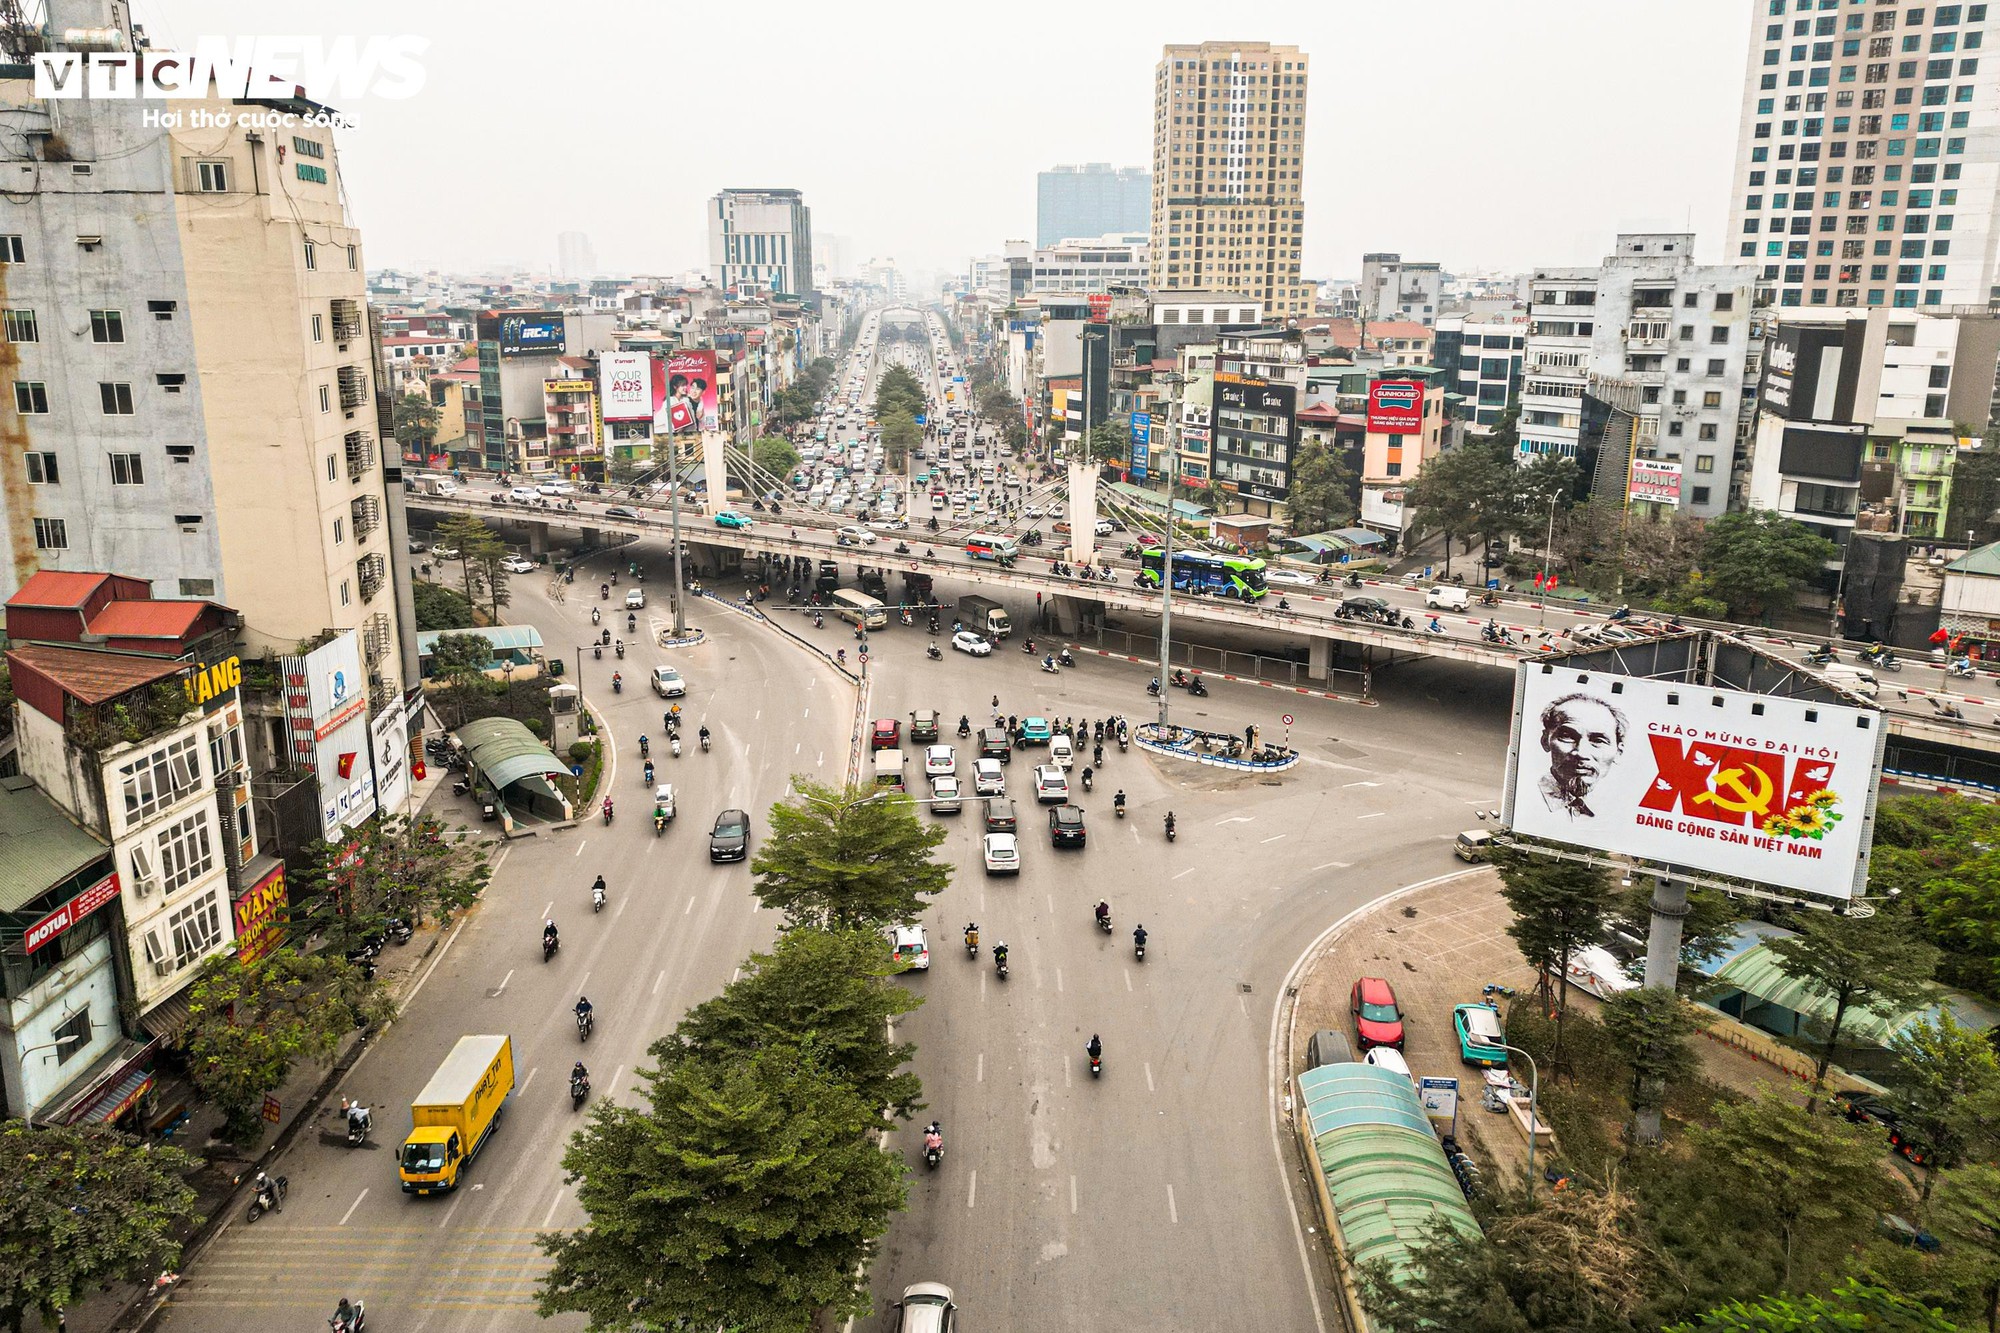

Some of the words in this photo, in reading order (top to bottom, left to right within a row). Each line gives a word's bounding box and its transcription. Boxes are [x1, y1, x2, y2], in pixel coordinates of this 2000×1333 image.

[522, 328, 542, 339] IRC
[609, 371, 642, 380] YOUR
[1241, 378, 1267, 387] Coffee
[612, 380, 642, 392] ADS
[612, 391, 642, 400] HERE
[1377, 390, 1418, 398] SUNHOUSE
[1635, 472, 1678, 487] HOÀNG
[184, 655, 241, 705] VÀNG
[1648, 722, 1698, 737] CHÀO
[1704, 730, 1758, 747] MỪNG
[1765, 740, 1797, 753] ĐẠI
[1805, 746, 1839, 761] HỘI
[1638, 734, 1836, 838] XIV
[1636, 813, 1673, 831] ĐẢNG
[1677, 821, 1716, 839] CỘNG
[1720, 828, 1749, 846] SẢN
[1754, 837, 1784, 853] VIỆT
[1787, 842, 1822, 860] NAM
[239, 874, 285, 927] VÀNG
[29, 912, 69, 949] MOTUL
